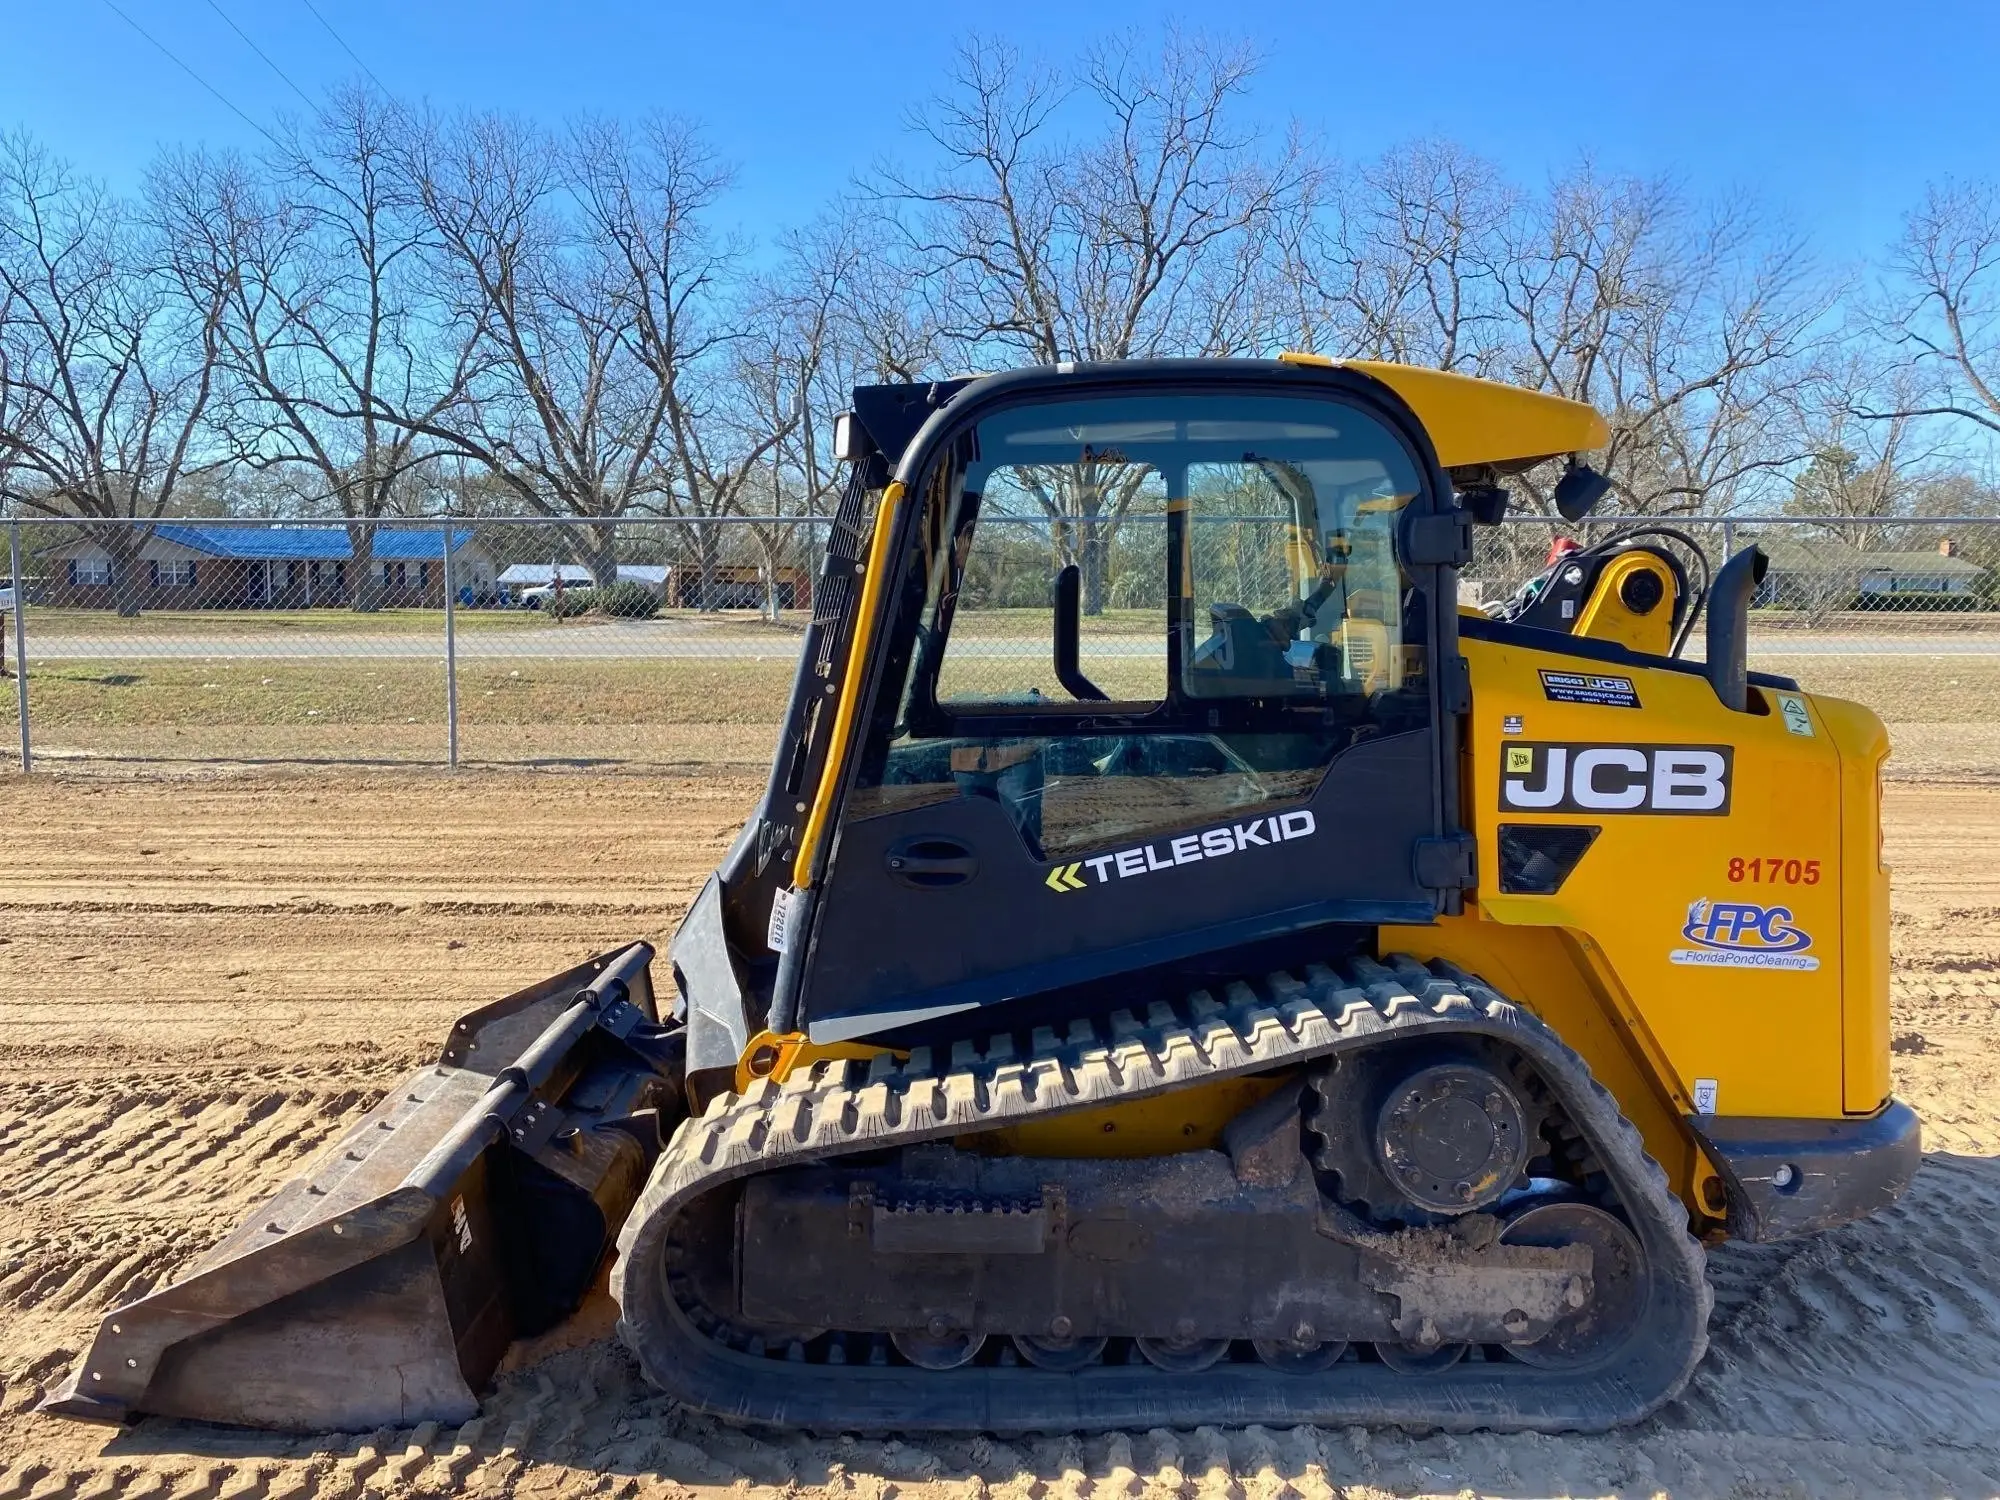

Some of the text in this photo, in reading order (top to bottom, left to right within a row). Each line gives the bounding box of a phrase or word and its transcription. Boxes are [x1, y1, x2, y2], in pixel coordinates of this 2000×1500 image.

[1546, 675, 1629, 691] BRIGGS JCB
[1513, 752, 1530, 767] JCB
[1505, 748, 1726, 811] JCB
[1085, 809, 1316, 883] TELESKID
[1727, 857, 1821, 886] 81705
[775, 905, 787, 944] 122876
[1704, 903, 1793, 943] FPC
[1685, 951, 1808, 969] FloridaPondCleaning
